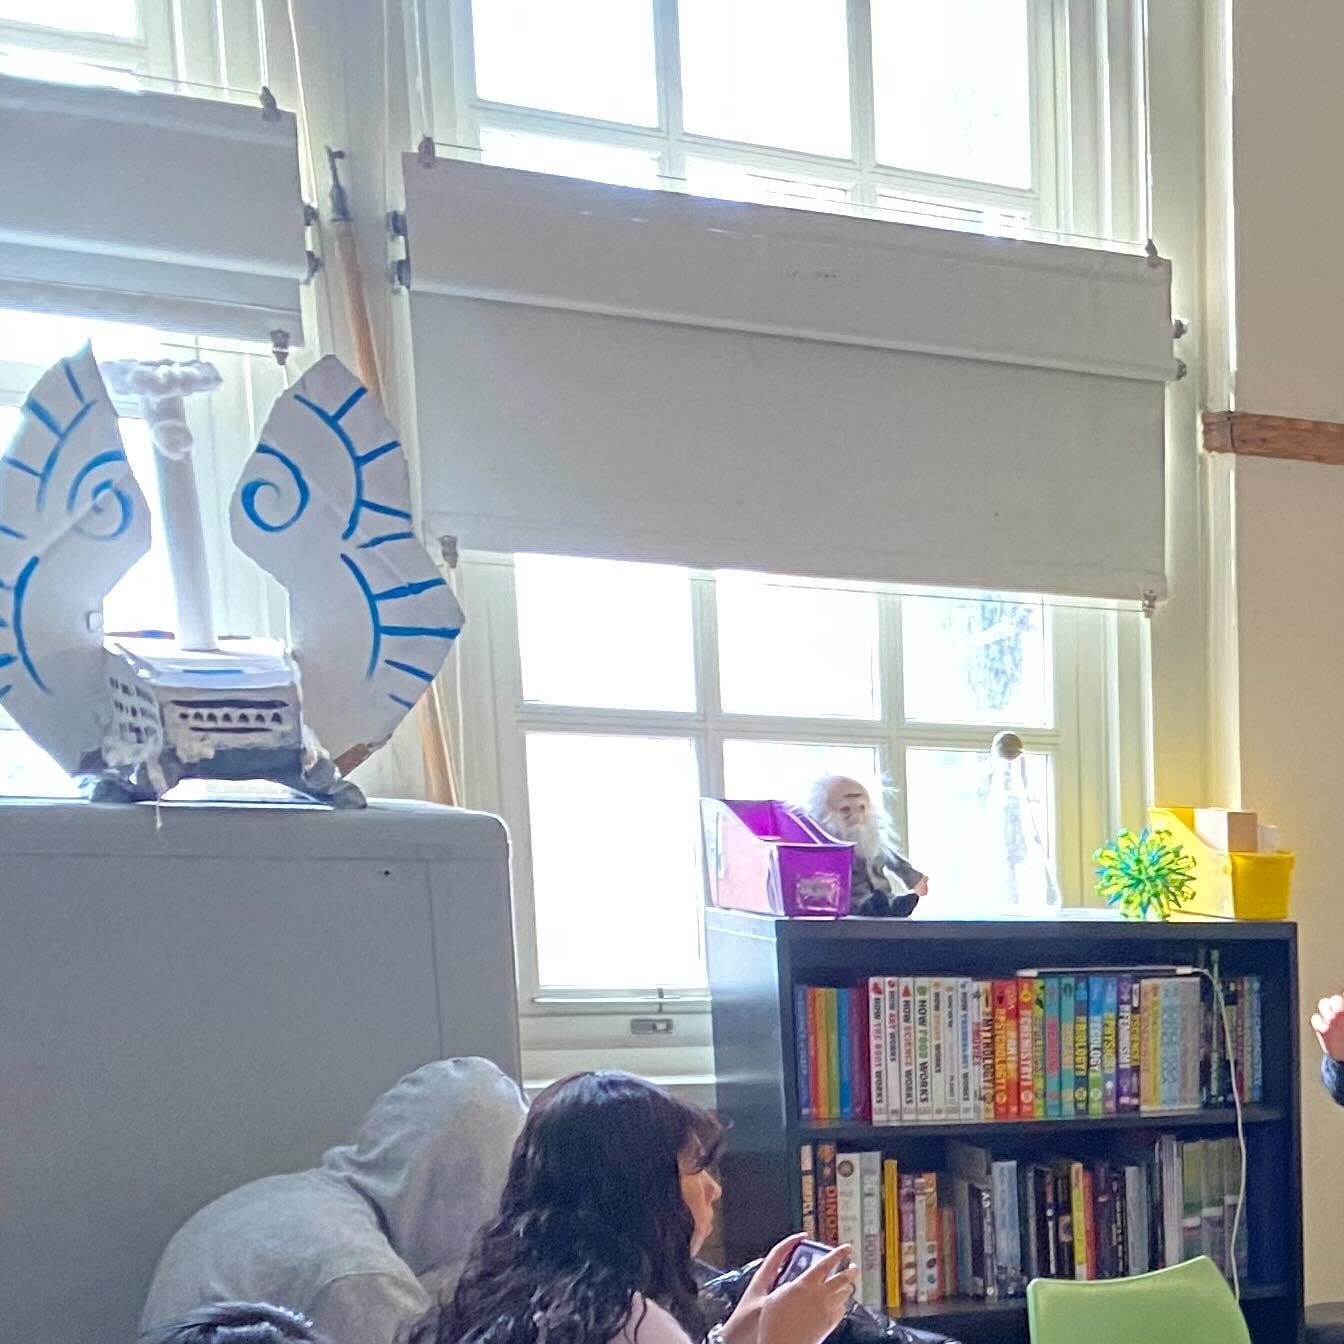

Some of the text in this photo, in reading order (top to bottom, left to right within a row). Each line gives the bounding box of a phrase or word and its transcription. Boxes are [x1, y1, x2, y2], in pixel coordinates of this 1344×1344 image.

[903, 1000, 912, 1024] HOW
[918, 1000, 929, 1103] HOW FOOD WORKS
[982, 1018, 994, 1084] MYTHOLOGY
[1020, 1017, 1031, 1081] CHEMISTRY
[1076, 1023, 1087, 1071] BIOLOGY
[1090, 1022, 1101, 1072] ECOLOGY
[875, 1070, 883, 1104] WORKS
[905, 1069, 914, 1105] WORKS
